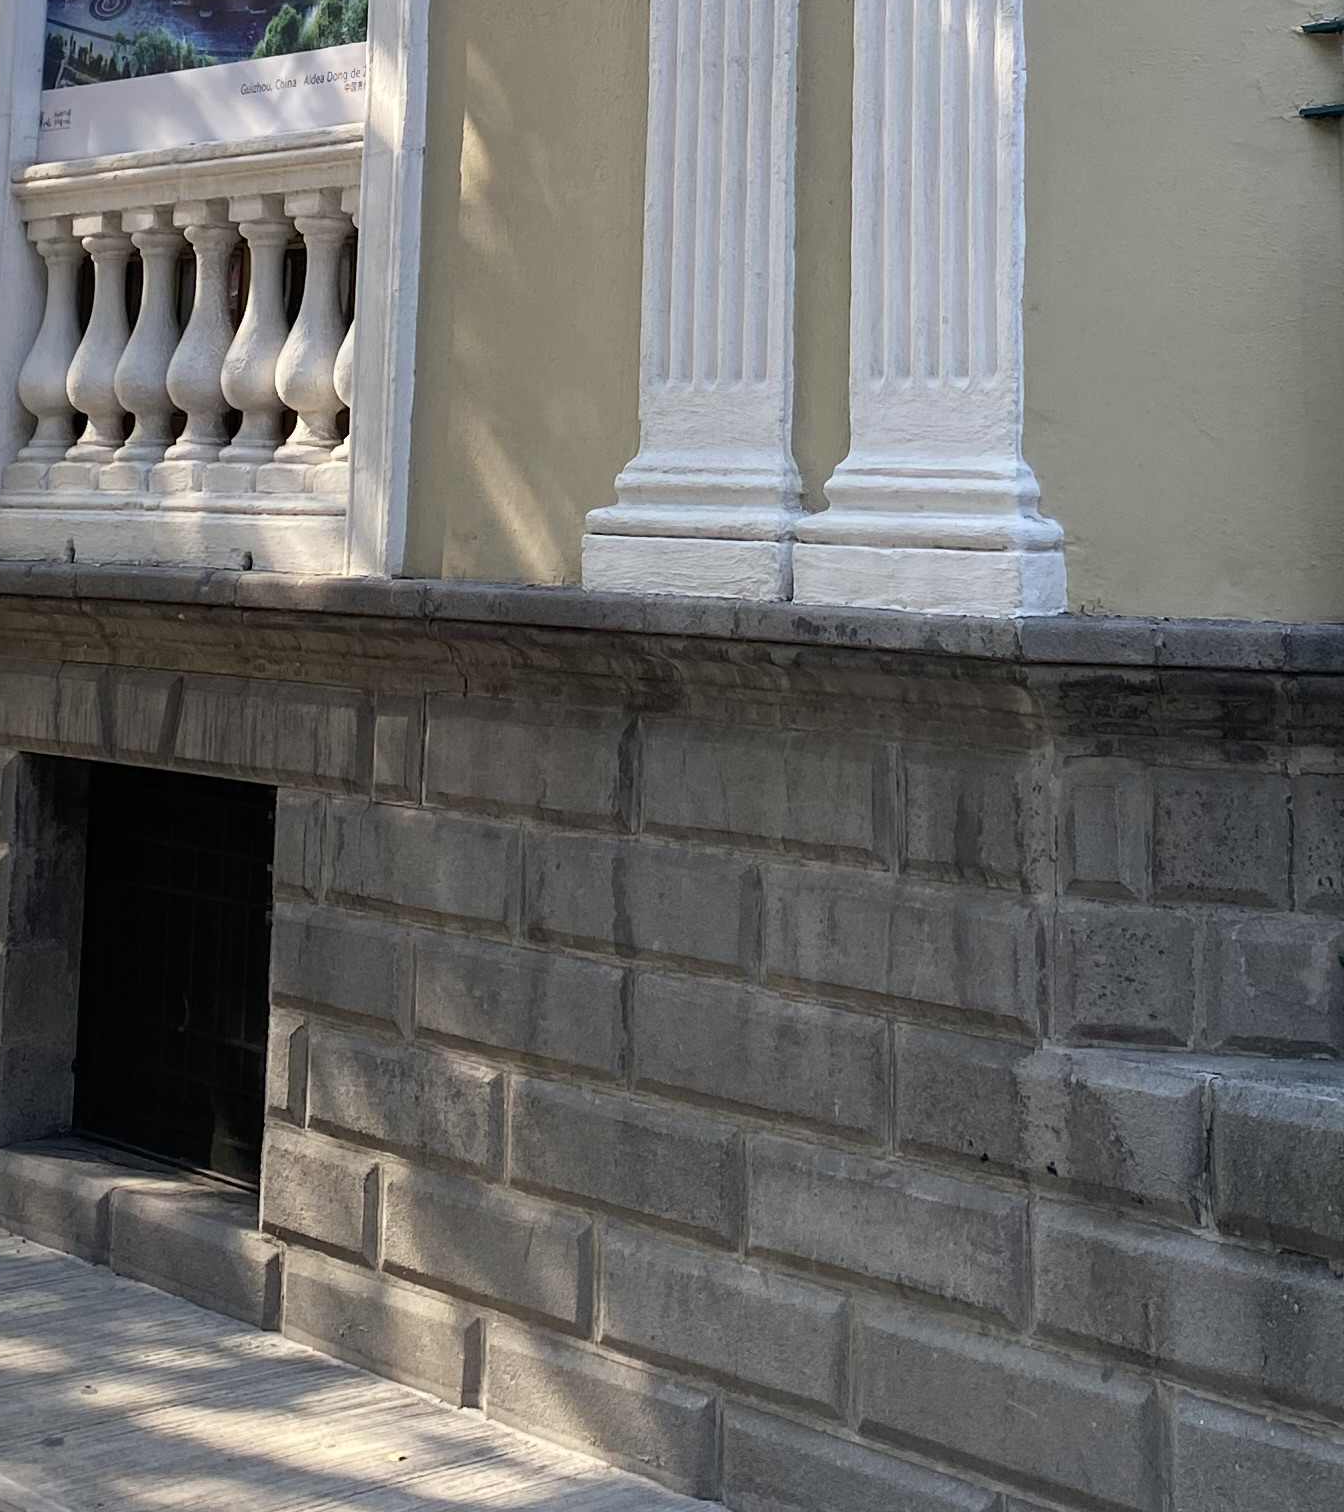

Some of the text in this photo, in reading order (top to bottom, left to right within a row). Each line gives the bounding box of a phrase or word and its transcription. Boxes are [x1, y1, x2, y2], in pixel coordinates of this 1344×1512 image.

[276, 78, 297, 90] China
[303, 73, 324, 86] Aldea
[327, 71, 348, 82] Dong
[350, 68, 361, 79] de
